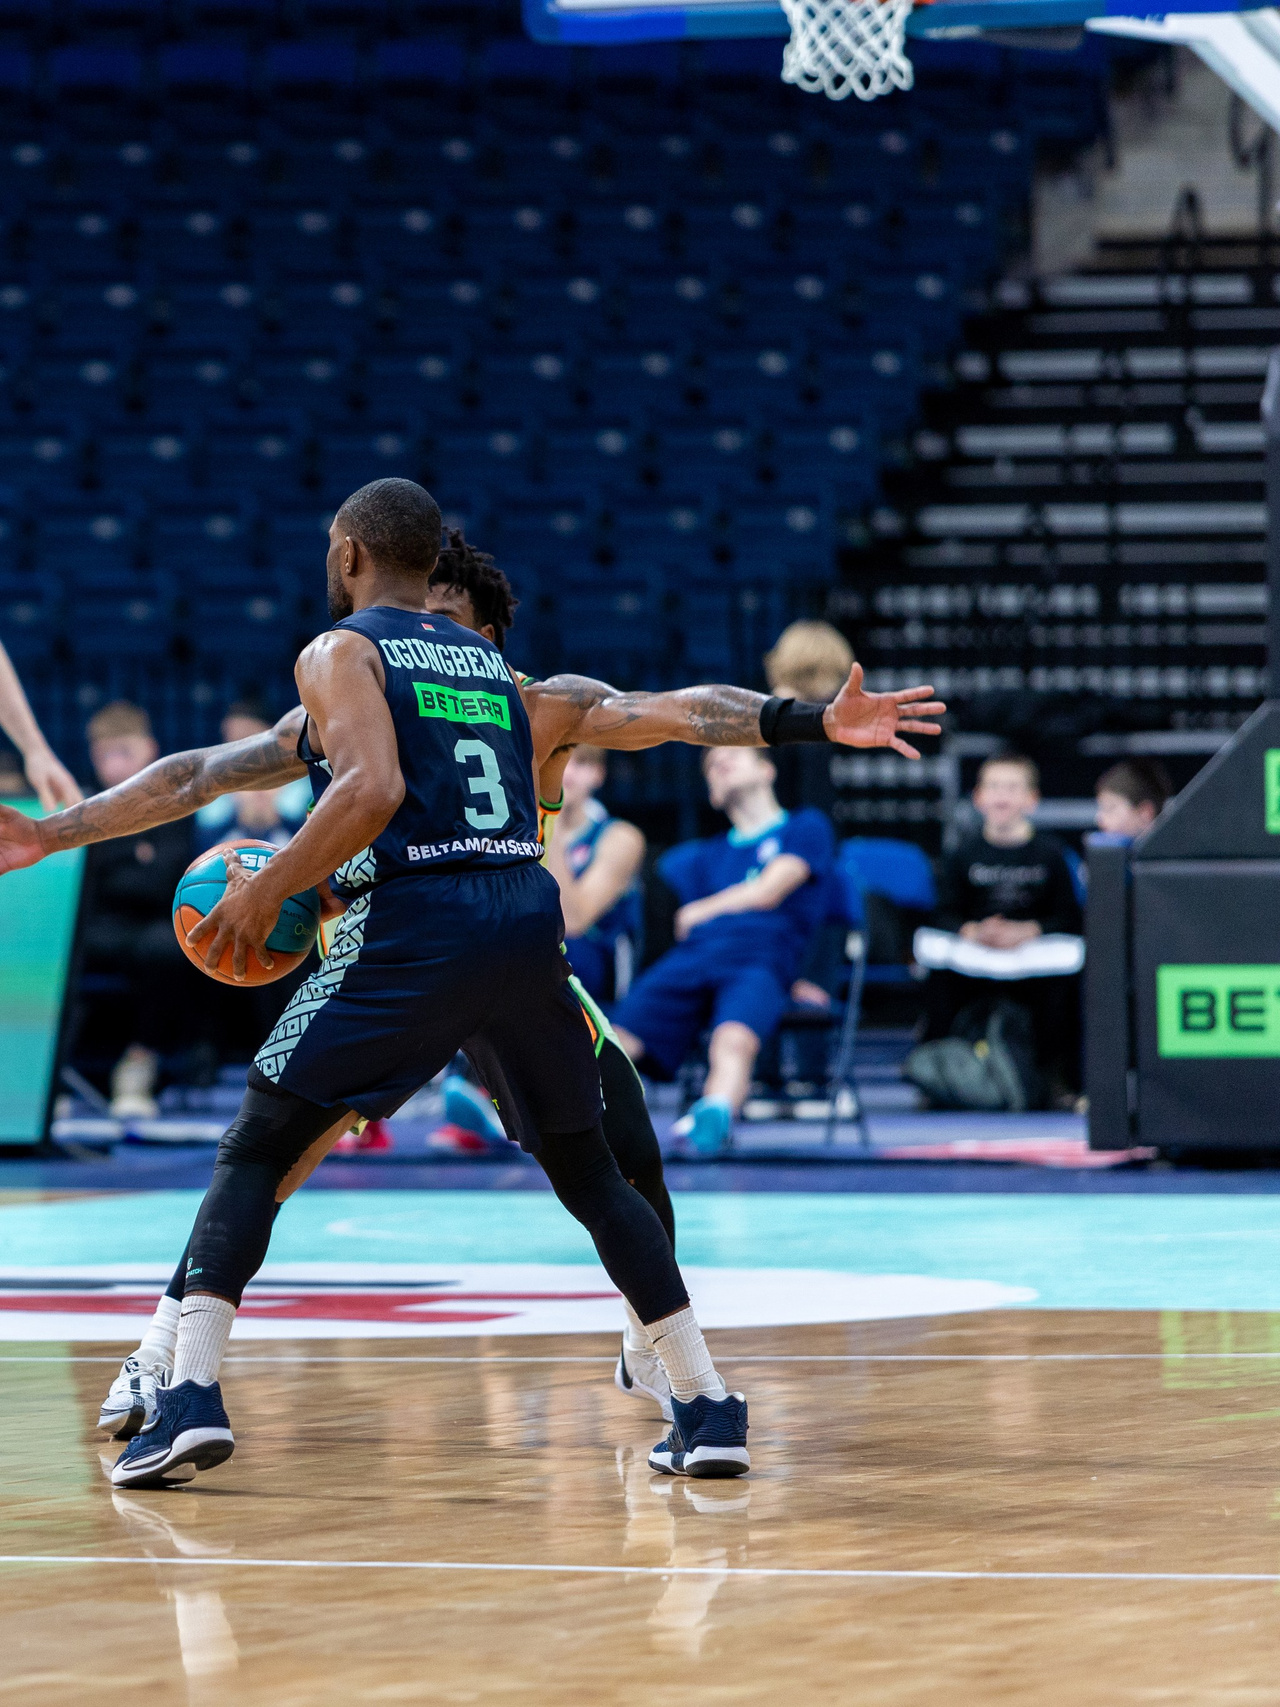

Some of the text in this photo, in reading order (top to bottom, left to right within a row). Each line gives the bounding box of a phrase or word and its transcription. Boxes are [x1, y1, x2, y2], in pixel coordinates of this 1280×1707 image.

[378, 638, 514, 684] OGUNGBEMI
[420, 690, 504, 722] BETERA
[453, 739, 510, 830] 3
[1180, 988, 1280, 1033] BE
